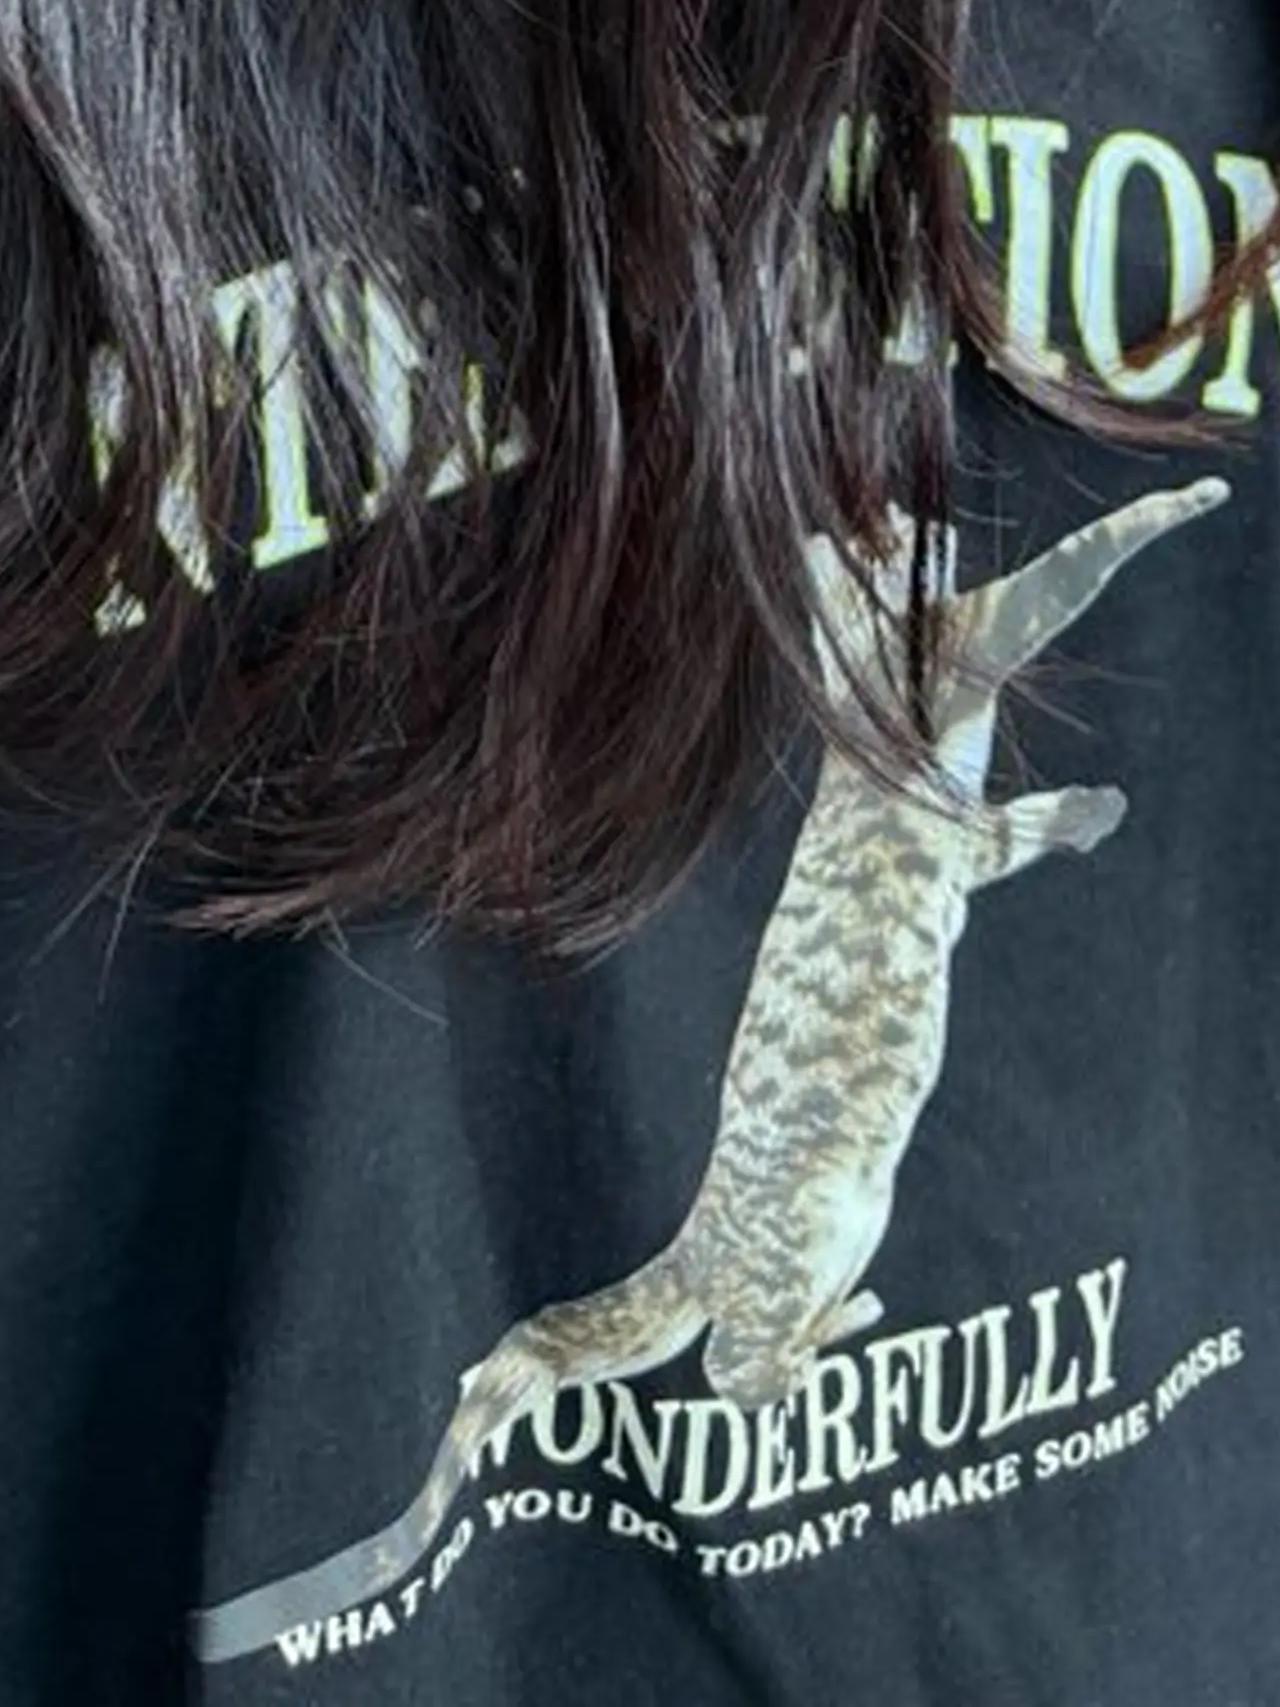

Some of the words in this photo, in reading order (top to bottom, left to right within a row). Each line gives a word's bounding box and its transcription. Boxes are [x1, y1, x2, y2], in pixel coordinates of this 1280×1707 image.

[275, 1578, 427, 1667] WHAT
[485, 1488, 592, 1529] YOU
[609, 1499, 680, 1555] DO
[696, 1503, 872, 1578] TODAY?
[890, 1453, 1021, 1525] MAKE
[1033, 1403, 1150, 1479] SOME
[1155, 1327, 1245, 1421] NOISE
